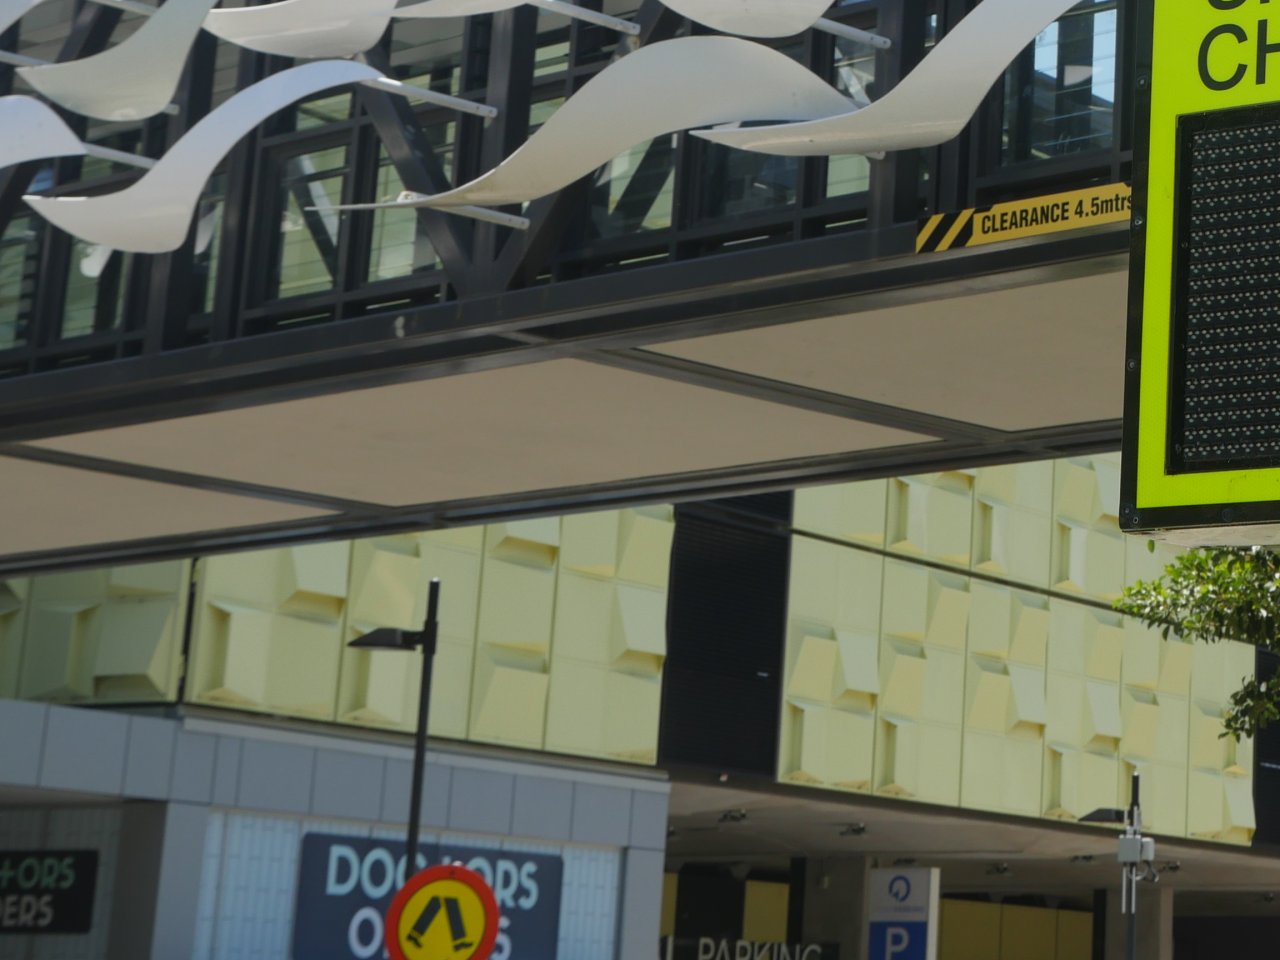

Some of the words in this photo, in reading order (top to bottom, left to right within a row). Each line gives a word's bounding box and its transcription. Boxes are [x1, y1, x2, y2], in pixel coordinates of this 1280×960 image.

[981, 202, 1069, 235] CLEARANCE
[326, 844, 539, 910] DOCORS
[0, 894, 54, 927] ERS
[887, 927, 909, 960] P
